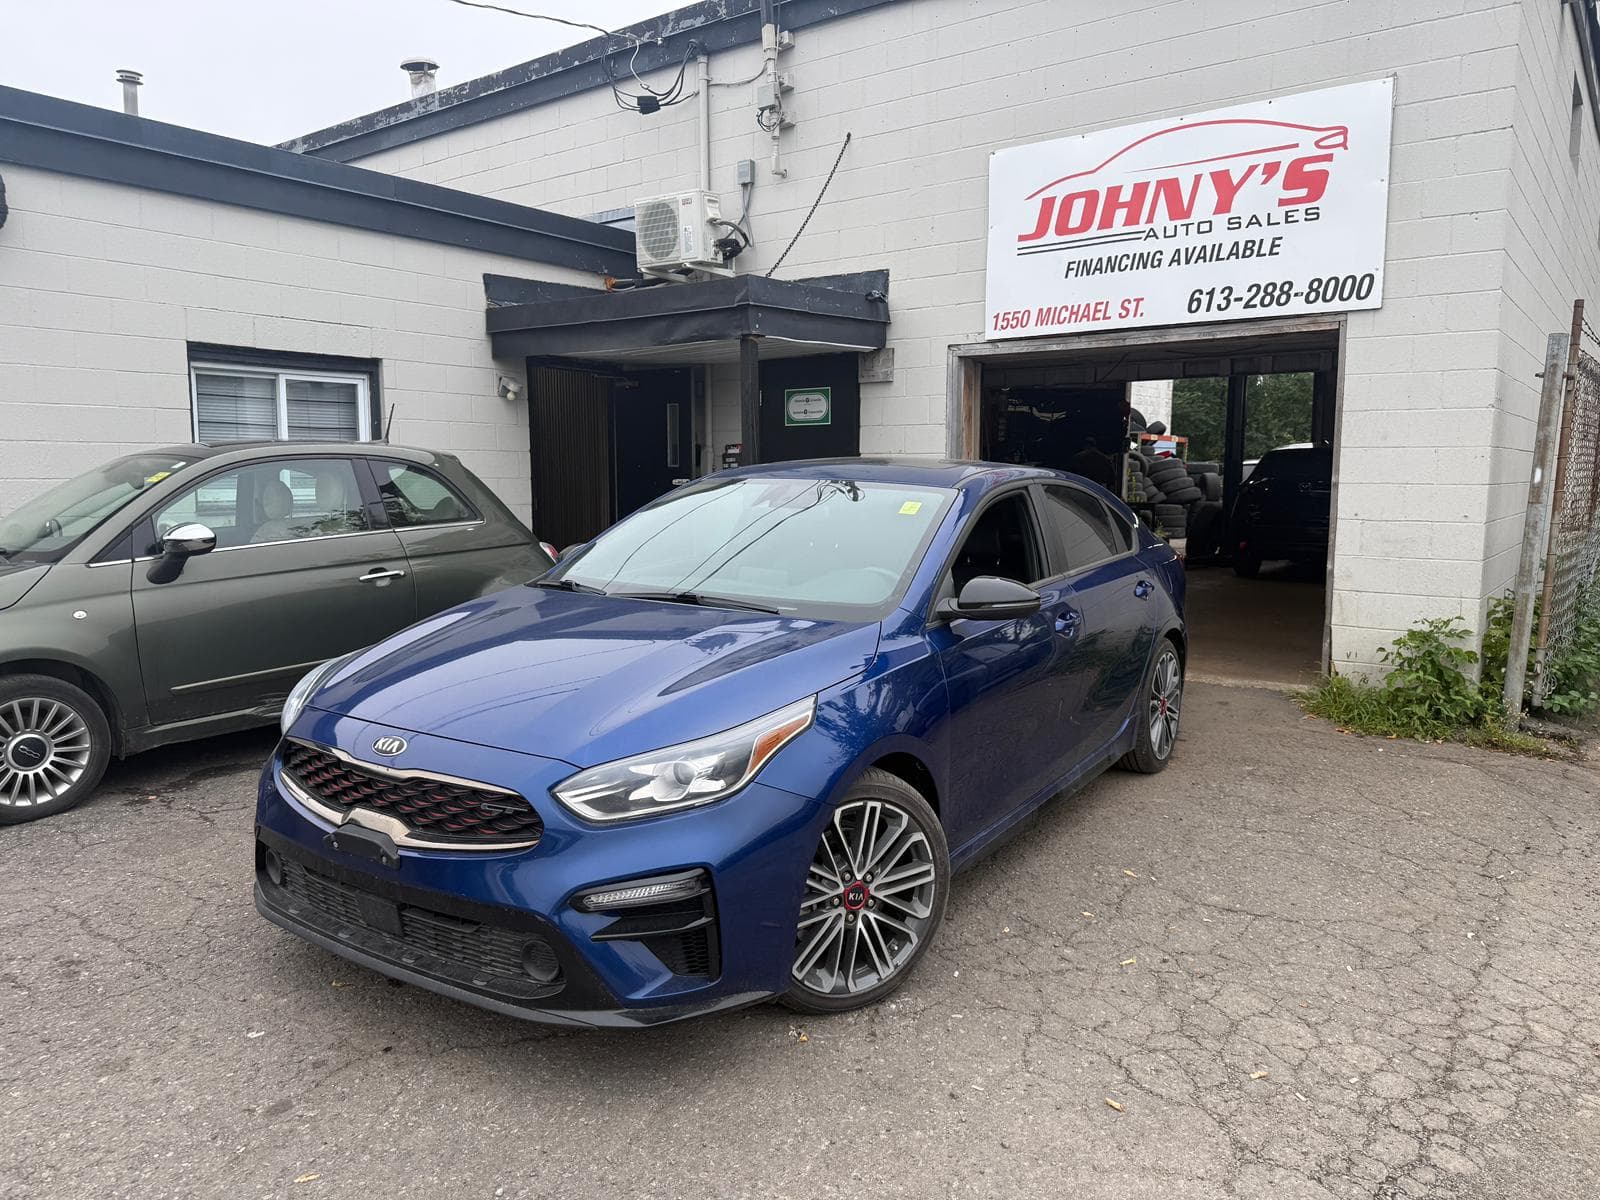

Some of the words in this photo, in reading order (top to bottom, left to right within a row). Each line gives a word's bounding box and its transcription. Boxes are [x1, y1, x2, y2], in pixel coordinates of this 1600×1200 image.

[1017, 153, 1334, 242] JOHNY'S
[1143, 219, 1213, 242] AUTO
[1227, 206, 1321, 231] SALES
[1064, 250, 1164, 279] FINANCING
[1168, 236, 1283, 267] AVAILABLE
[1187, 273, 1375, 314] 613-288-8000
[993, 309, 1031, 331] 1550
[1034, 301, 1112, 327] MICHAEL
[1118, 297, 1145, 319] ST.
[374, 737, 401, 753] KIA
[848, 892, 864, 901] KIA
